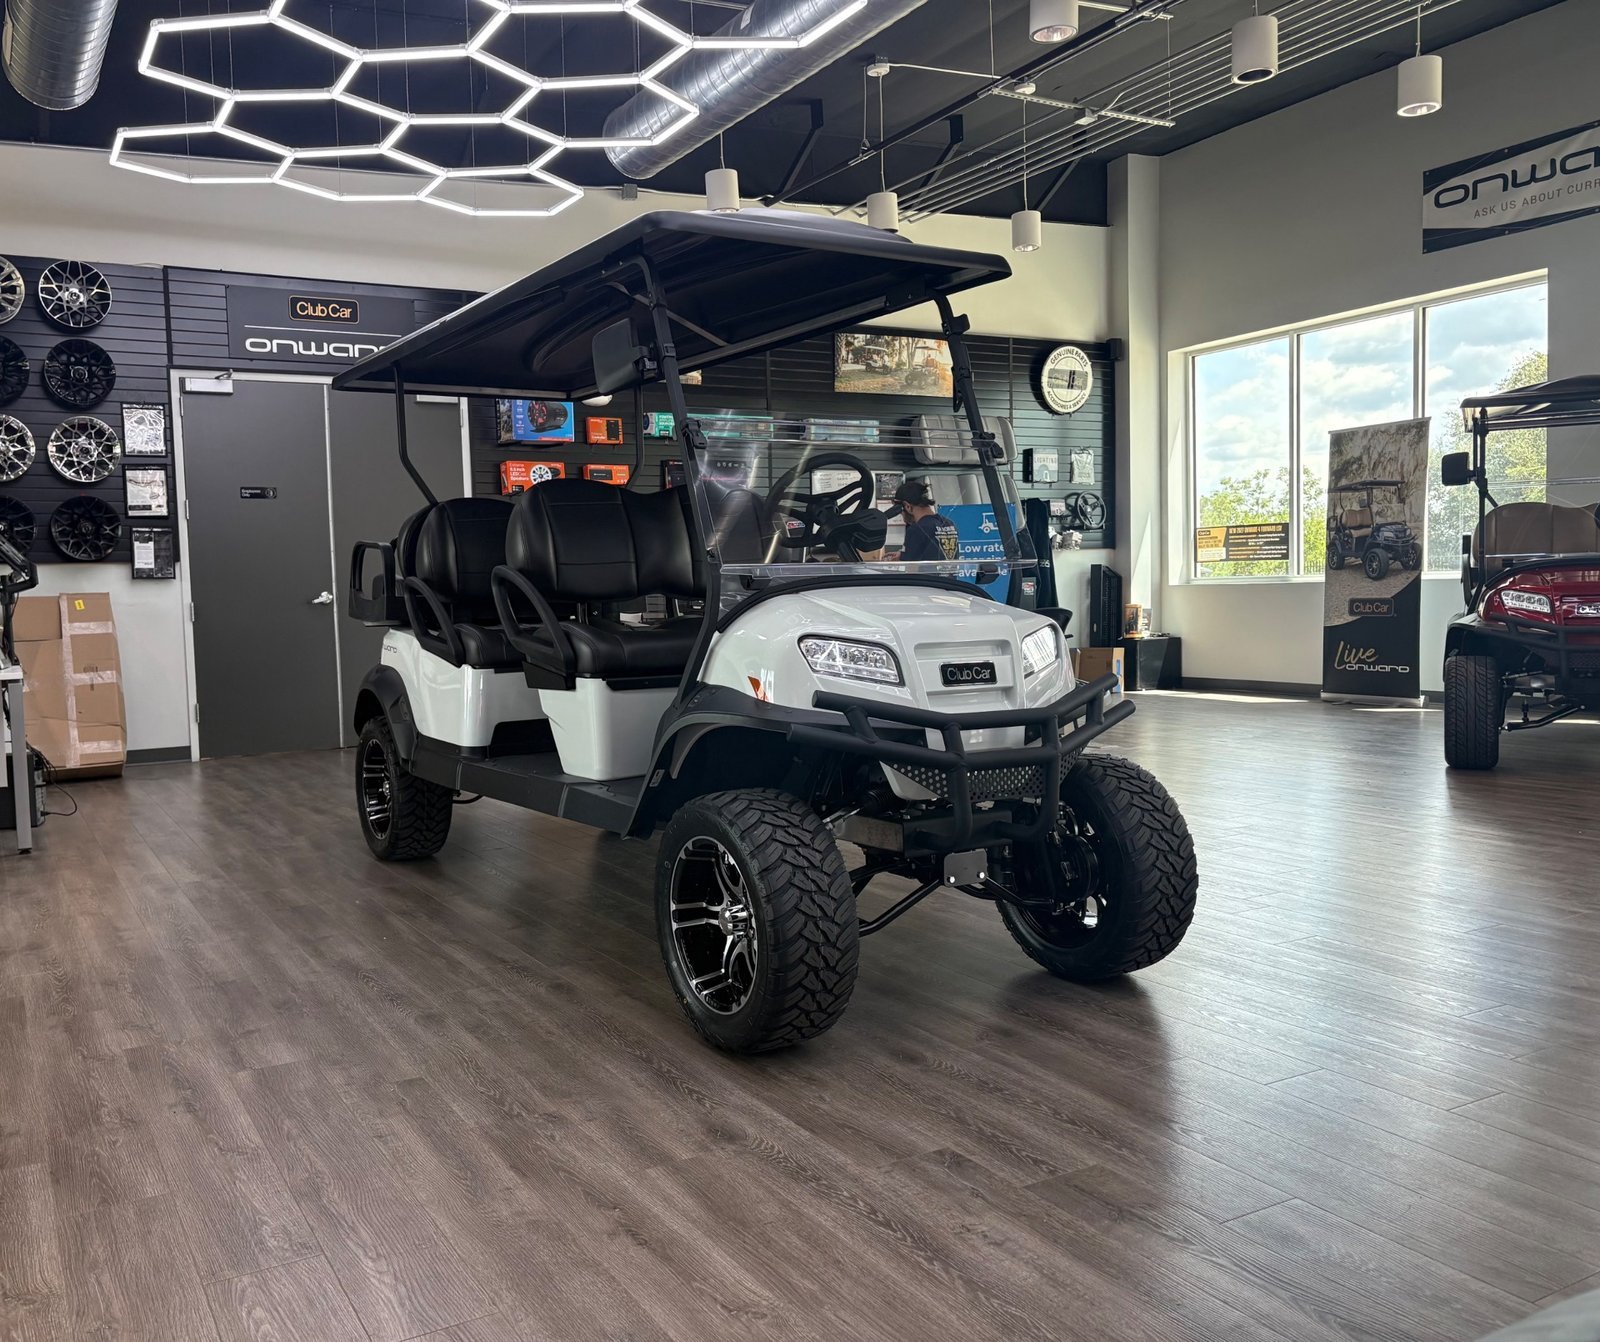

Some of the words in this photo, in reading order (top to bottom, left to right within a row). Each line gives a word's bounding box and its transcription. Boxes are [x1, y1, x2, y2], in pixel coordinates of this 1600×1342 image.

[1474, 205, 1497, 219] ASK
[1501, 200, 1517, 212] US
[1522, 188, 1562, 206] ABOUT
[296, 301, 327, 317] Club
[328, 303, 353, 319] Car
[245, 338, 388, 358] onwar
[1050, 349, 1075, 365] GENUINE
[1074, 350, 1089, 368] PARTS
[958, 543, 980, 553] Low
[958, 566, 1008, 577] avale
[1353, 602, 1373, 613] Club
[1373, 602, 1390, 613] Car
[1334, 641, 1378, 670] Live
[947, 667, 972, 680] Club
[973, 666, 991, 679] Car
